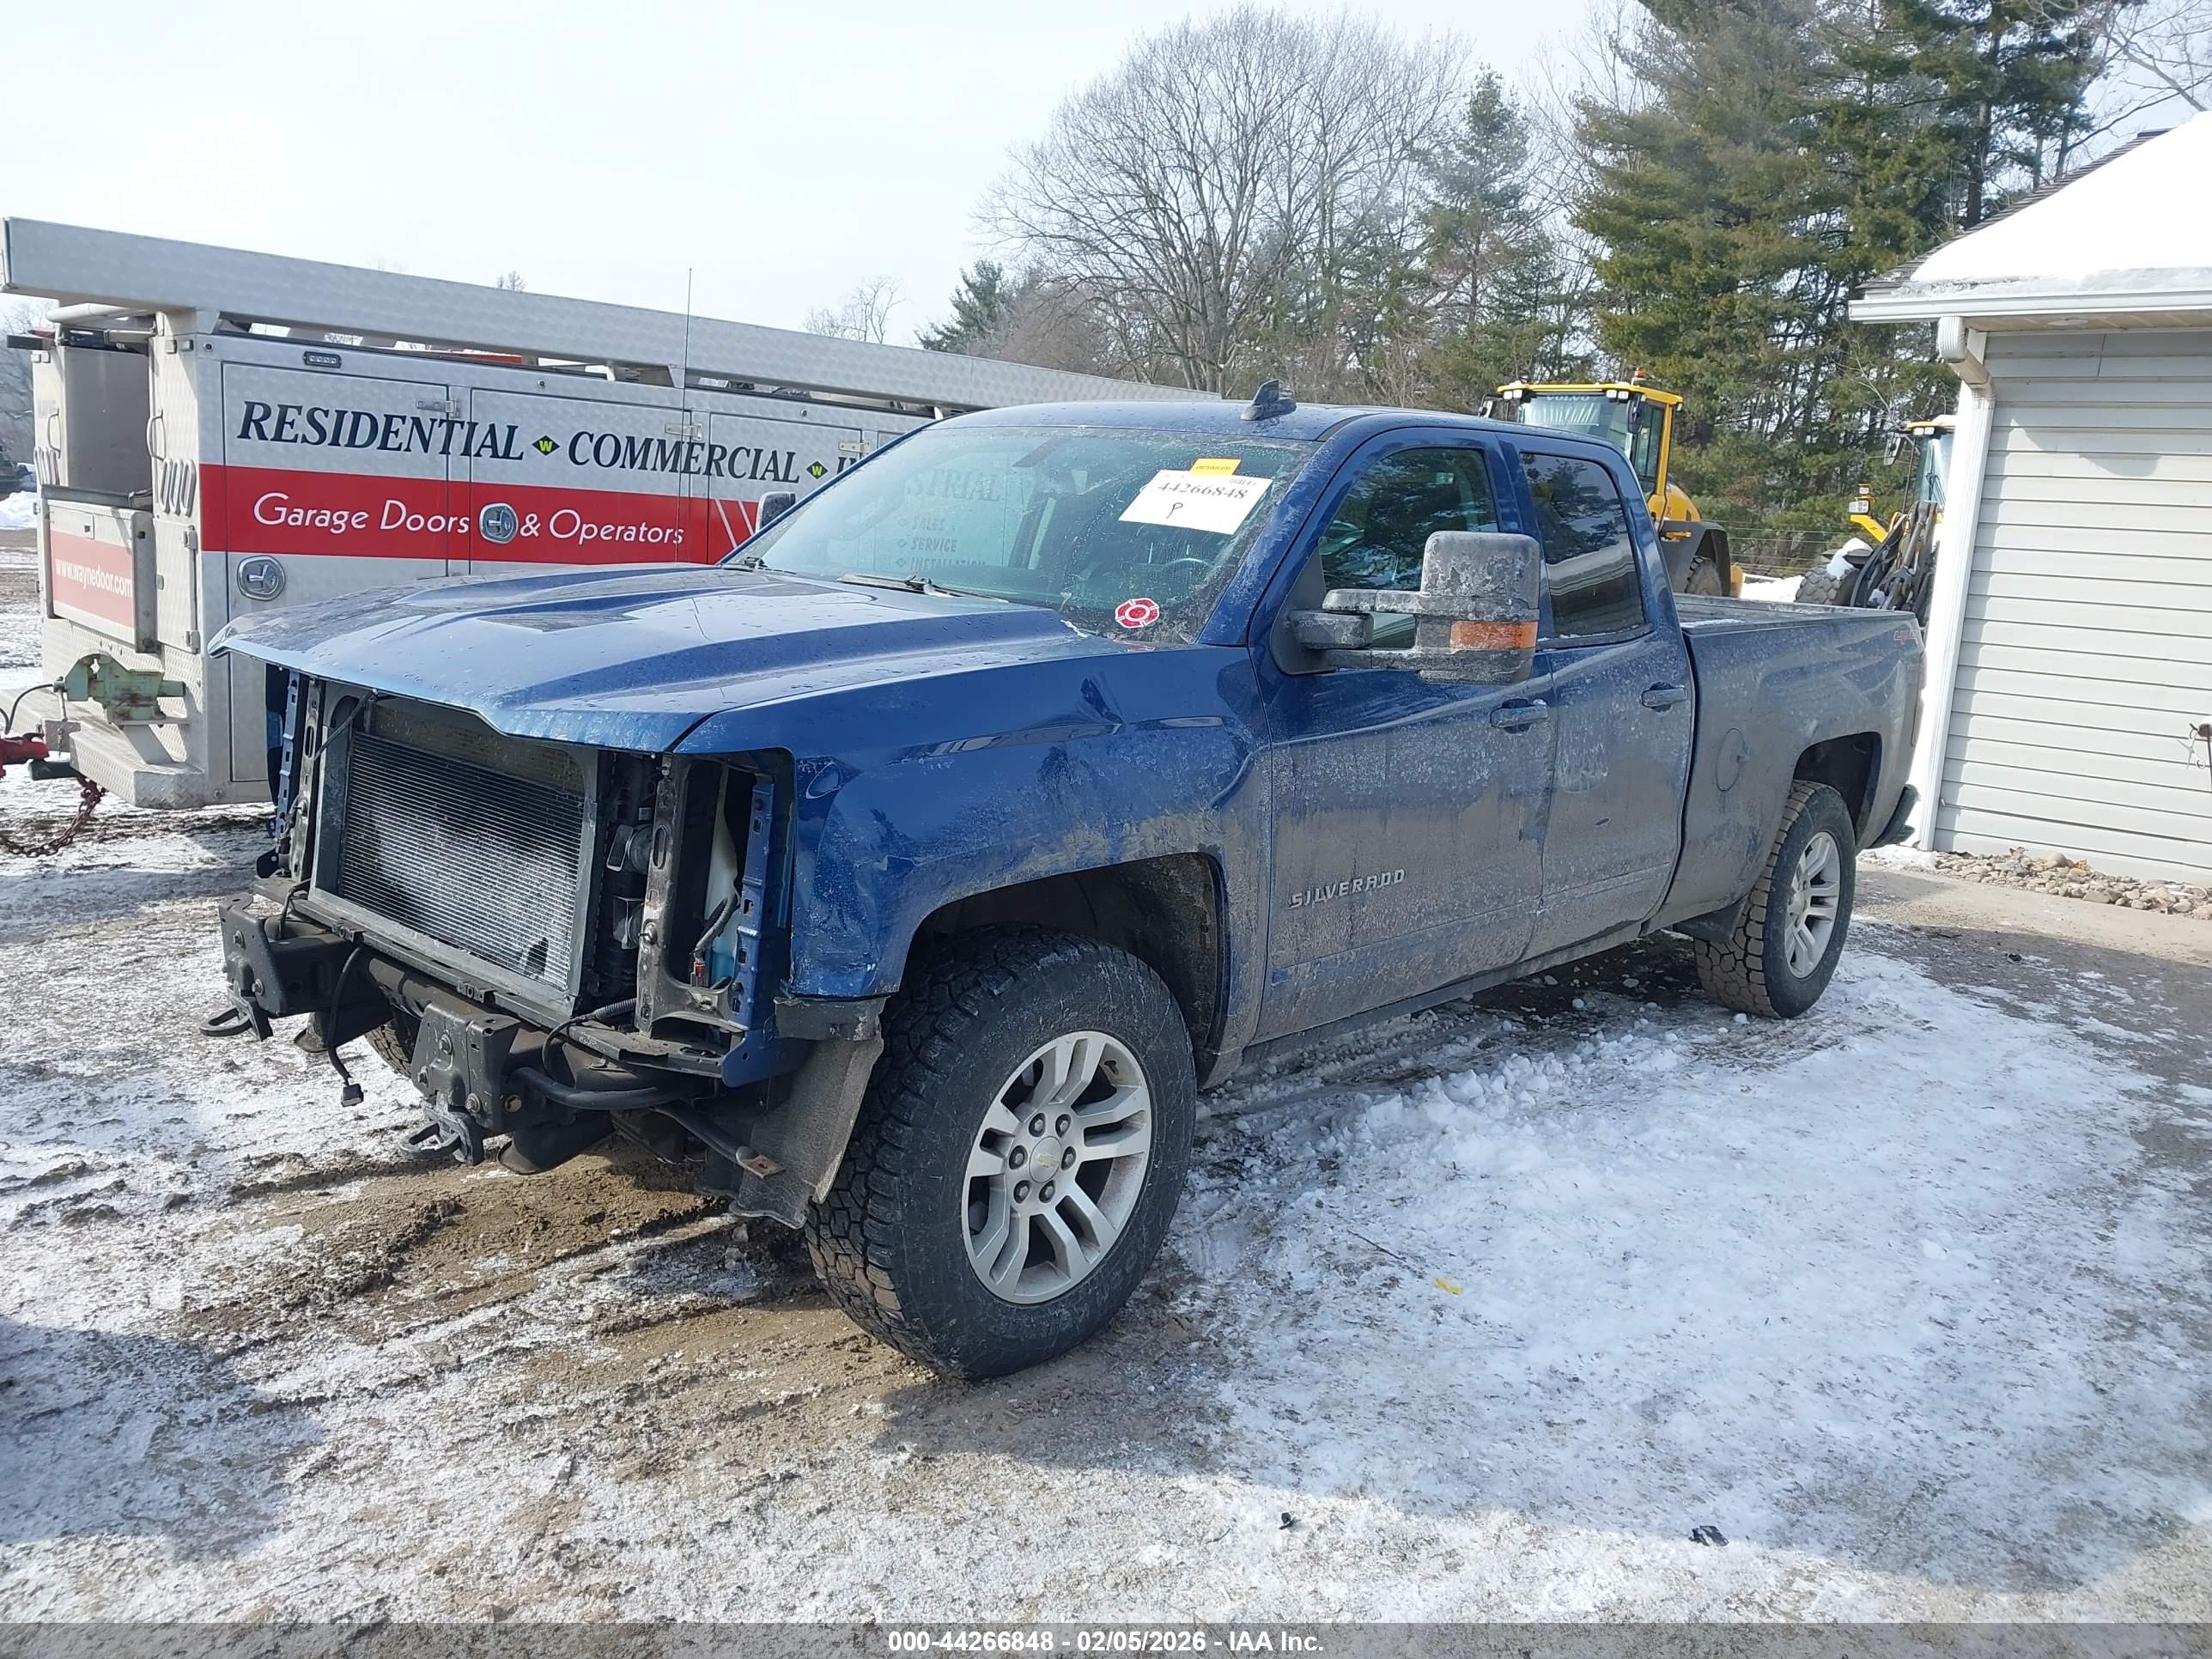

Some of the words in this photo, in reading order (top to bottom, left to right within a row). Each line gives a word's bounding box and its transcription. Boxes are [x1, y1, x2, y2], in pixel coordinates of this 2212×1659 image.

[237, 400, 525, 461] RESIDENTIAL
[538, 440, 553, 452] W
[568, 431, 800, 483] COMMERCIAL
[811, 465, 823, 476] W
[1158, 481, 1249, 500] 44266848
[253, 492, 369, 534] Garage
[380, 499, 470, 533] Doors
[520, 513, 542, 538] &
[549, 508, 684, 544] Operators
[911, 515, 945, 532] SALES
[910, 536, 958, 552] SERVICE
[54, 557, 133, 599] www.waynedoor.com
[1288, 868, 1406, 910] SILVERADO
